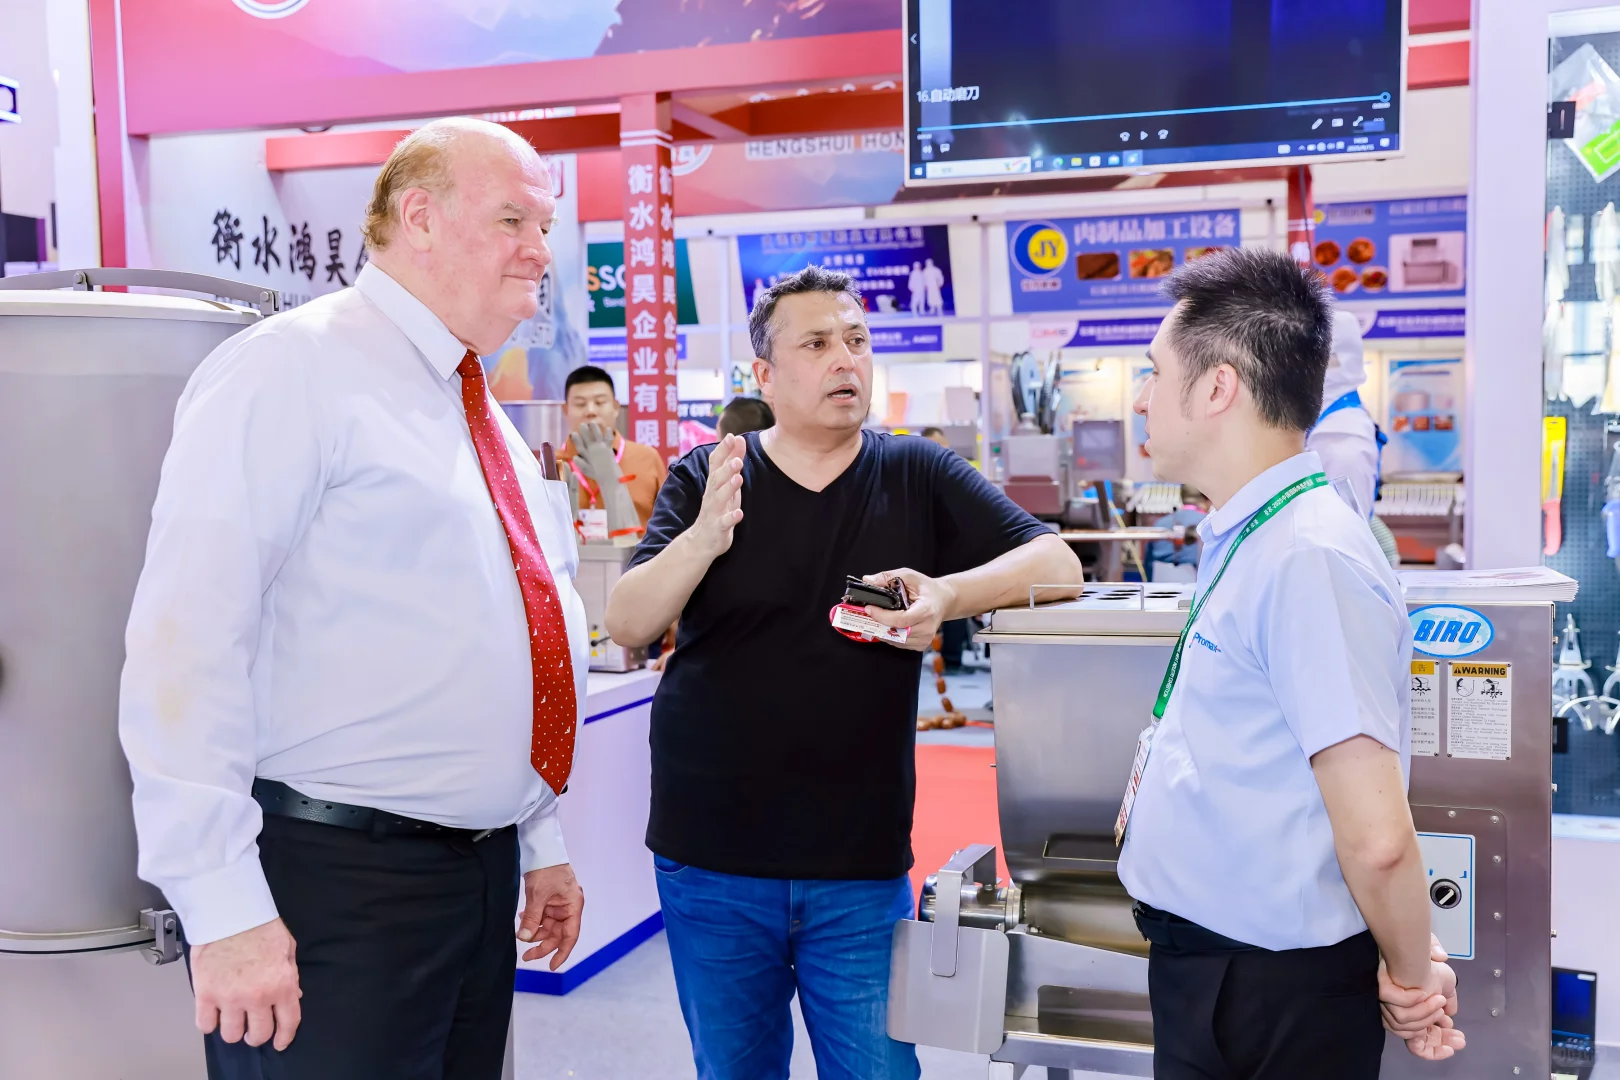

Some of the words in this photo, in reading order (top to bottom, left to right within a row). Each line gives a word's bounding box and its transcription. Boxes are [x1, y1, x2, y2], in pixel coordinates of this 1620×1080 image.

[747, 135, 853, 159] HENGSHUI
[1074, 213, 1236, 246] 肉制品加工设备
[1413, 619, 1482, 643] BIRO
[1462, 666, 1506, 676] WARNING
